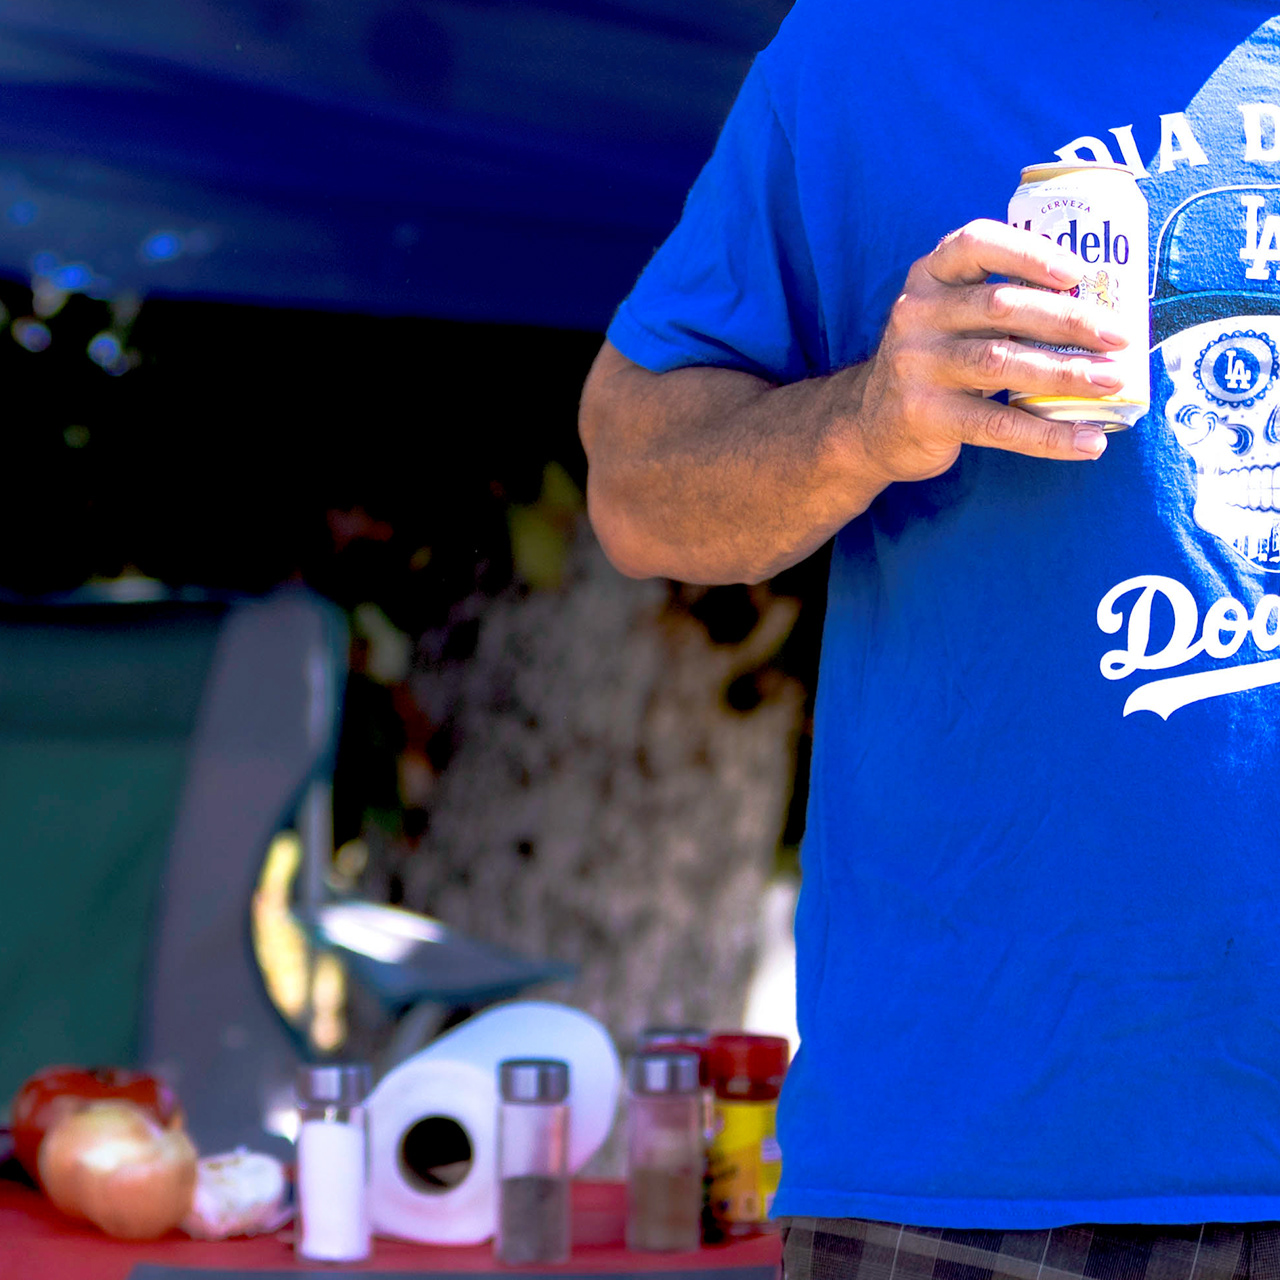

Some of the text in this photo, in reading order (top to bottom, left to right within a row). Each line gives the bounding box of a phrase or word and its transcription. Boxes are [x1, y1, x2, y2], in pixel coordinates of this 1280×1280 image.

[1041, 199, 1091, 214] CERVEZA
[1012, 219, 1130, 265] delo
[1224, 349, 1252, 390] LA
